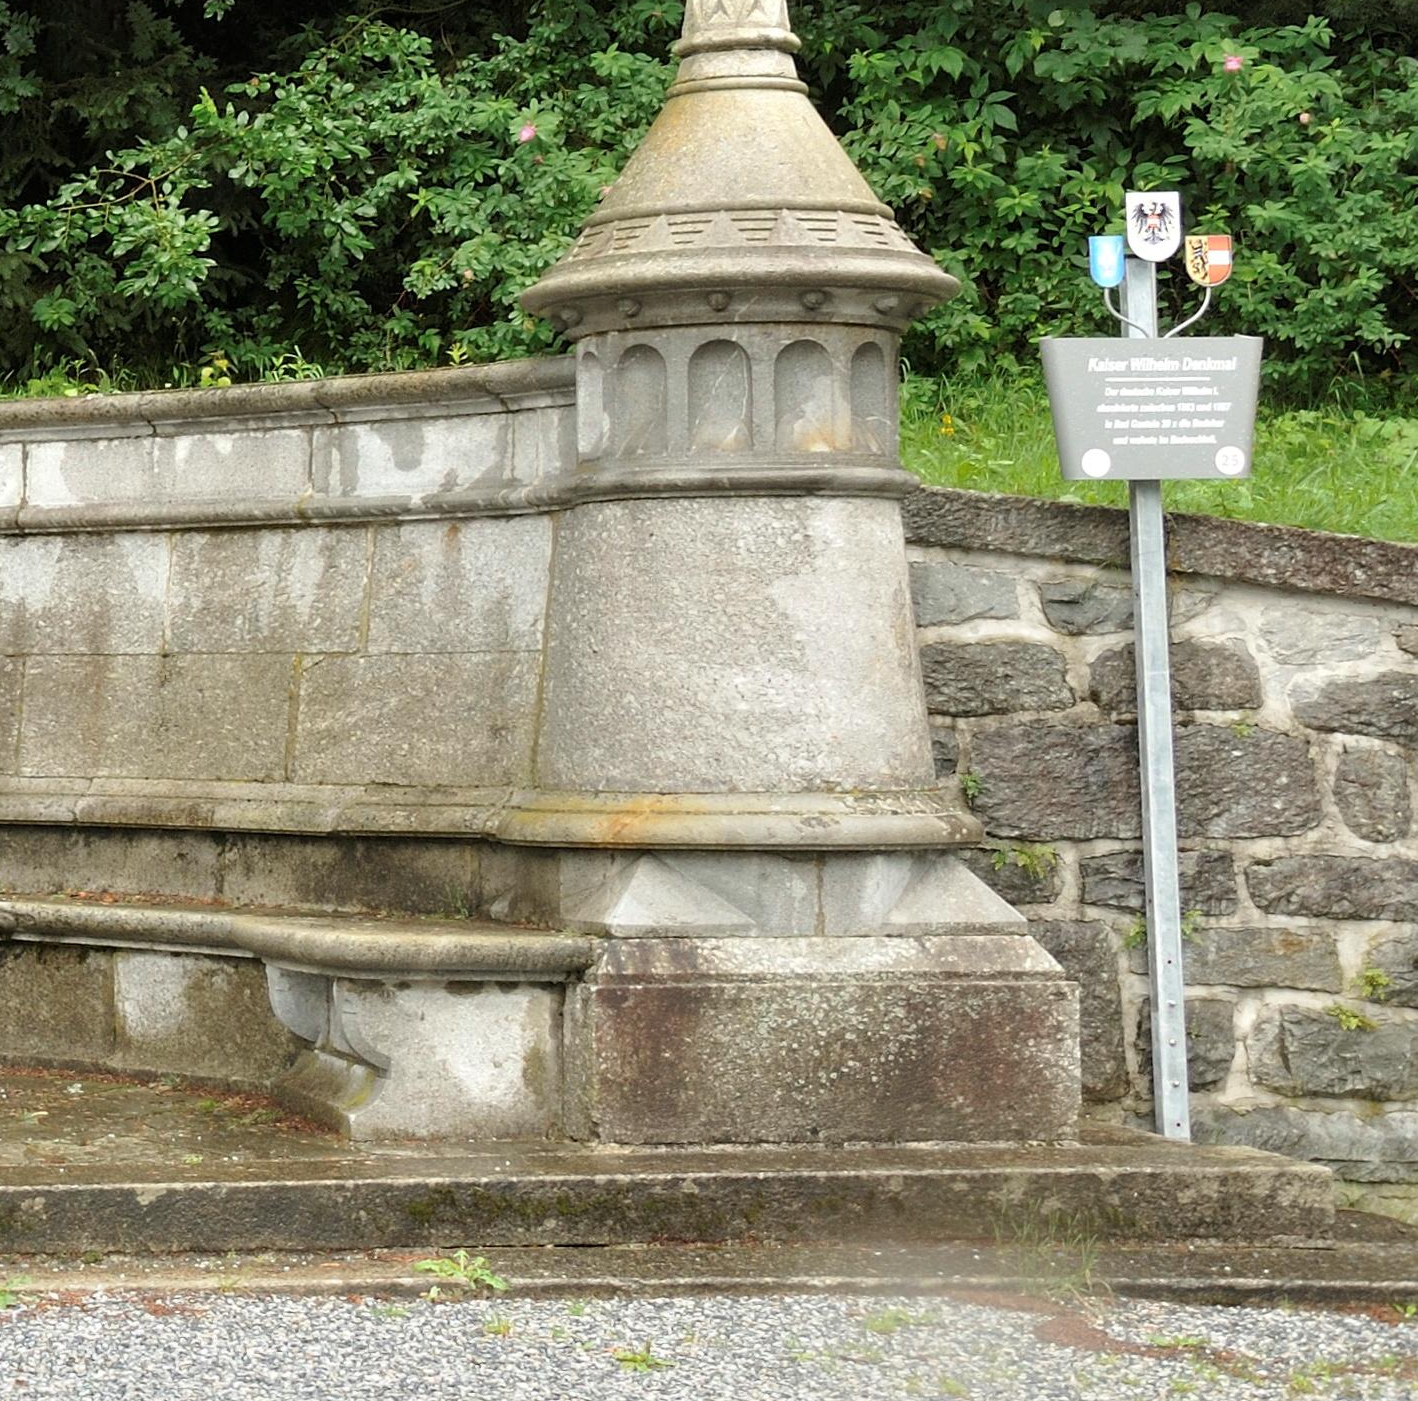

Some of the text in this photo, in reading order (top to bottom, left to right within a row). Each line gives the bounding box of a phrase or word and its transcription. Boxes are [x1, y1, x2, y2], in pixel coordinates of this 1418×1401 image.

[1088, 356, 1237, 372] Kaiser Wilhelm Denkmal
[1222, 454, 1239, 467] 25
